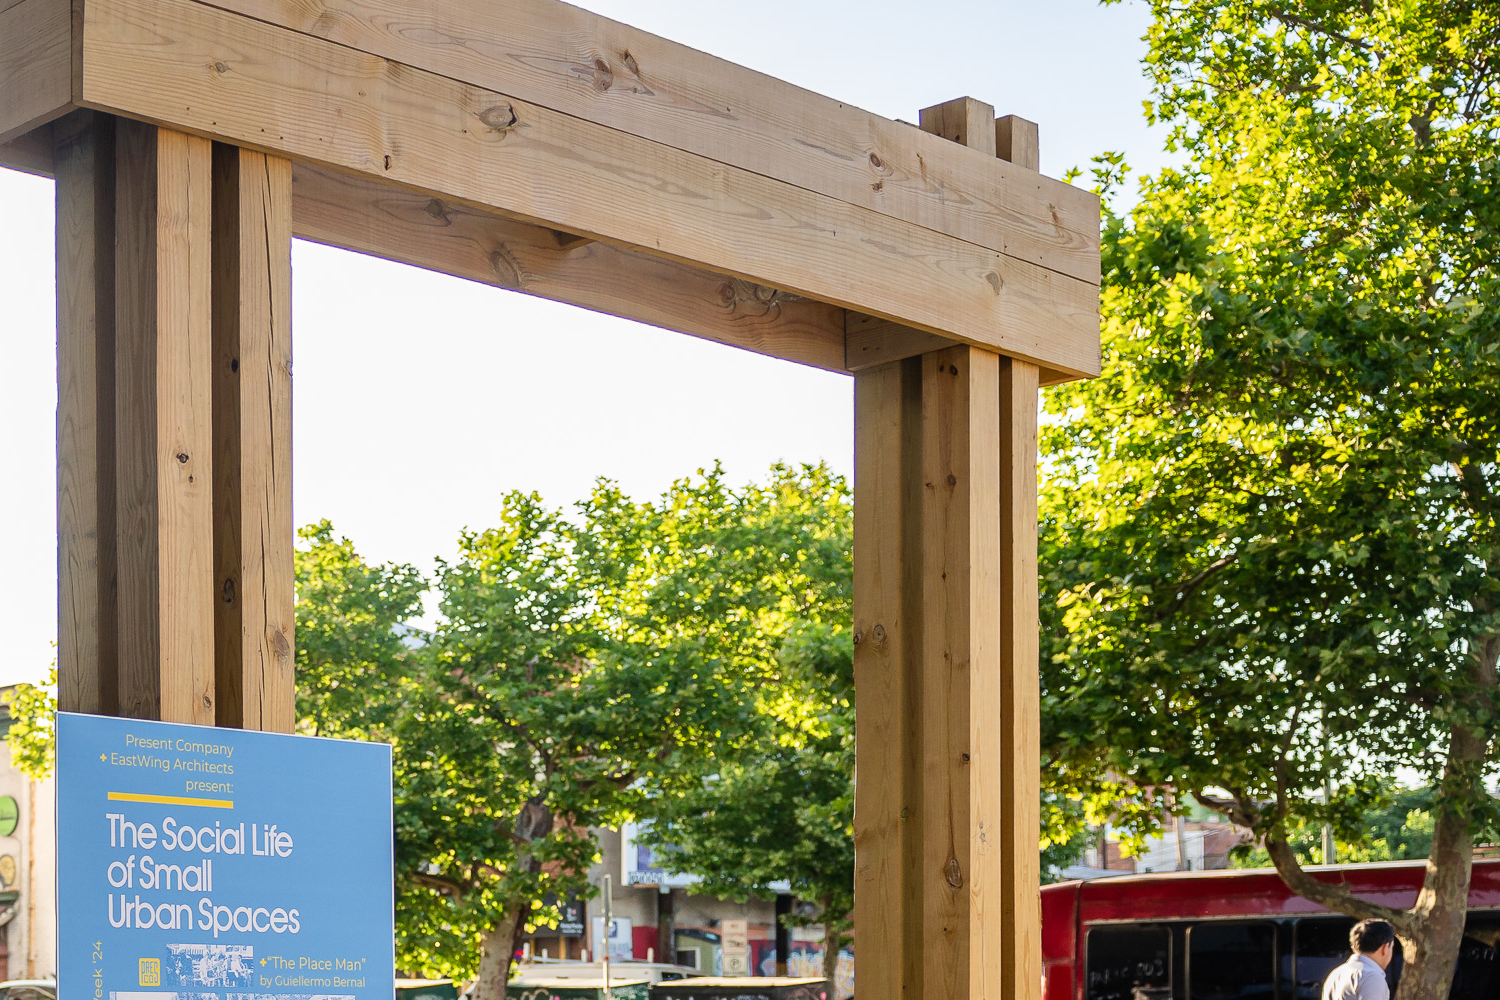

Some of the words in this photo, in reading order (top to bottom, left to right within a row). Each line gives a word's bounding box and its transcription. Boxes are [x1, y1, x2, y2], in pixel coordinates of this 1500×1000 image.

[125, 734, 173, 750] Present
[175, 739, 234, 758] Company
[111, 752, 170, 772] EastWing
[173, 758, 234, 775] Architects
[186, 780, 234, 793] present:
[106, 813, 158, 849] The
[162, 817, 245, 855] Social
[252, 823, 294, 858] Life
[107, 855, 137, 888] of
[139, 855, 212, 891] Small
[108, 894, 194, 930] Urban
[198, 898, 300, 938] Spaces
[92, 941, 102, 964] '24
[299, 957, 332, 970] Place
[260, 975, 272, 989] by
[274, 976, 331, 988] Guiellermo
[333, 976, 366, 988] Bernal
